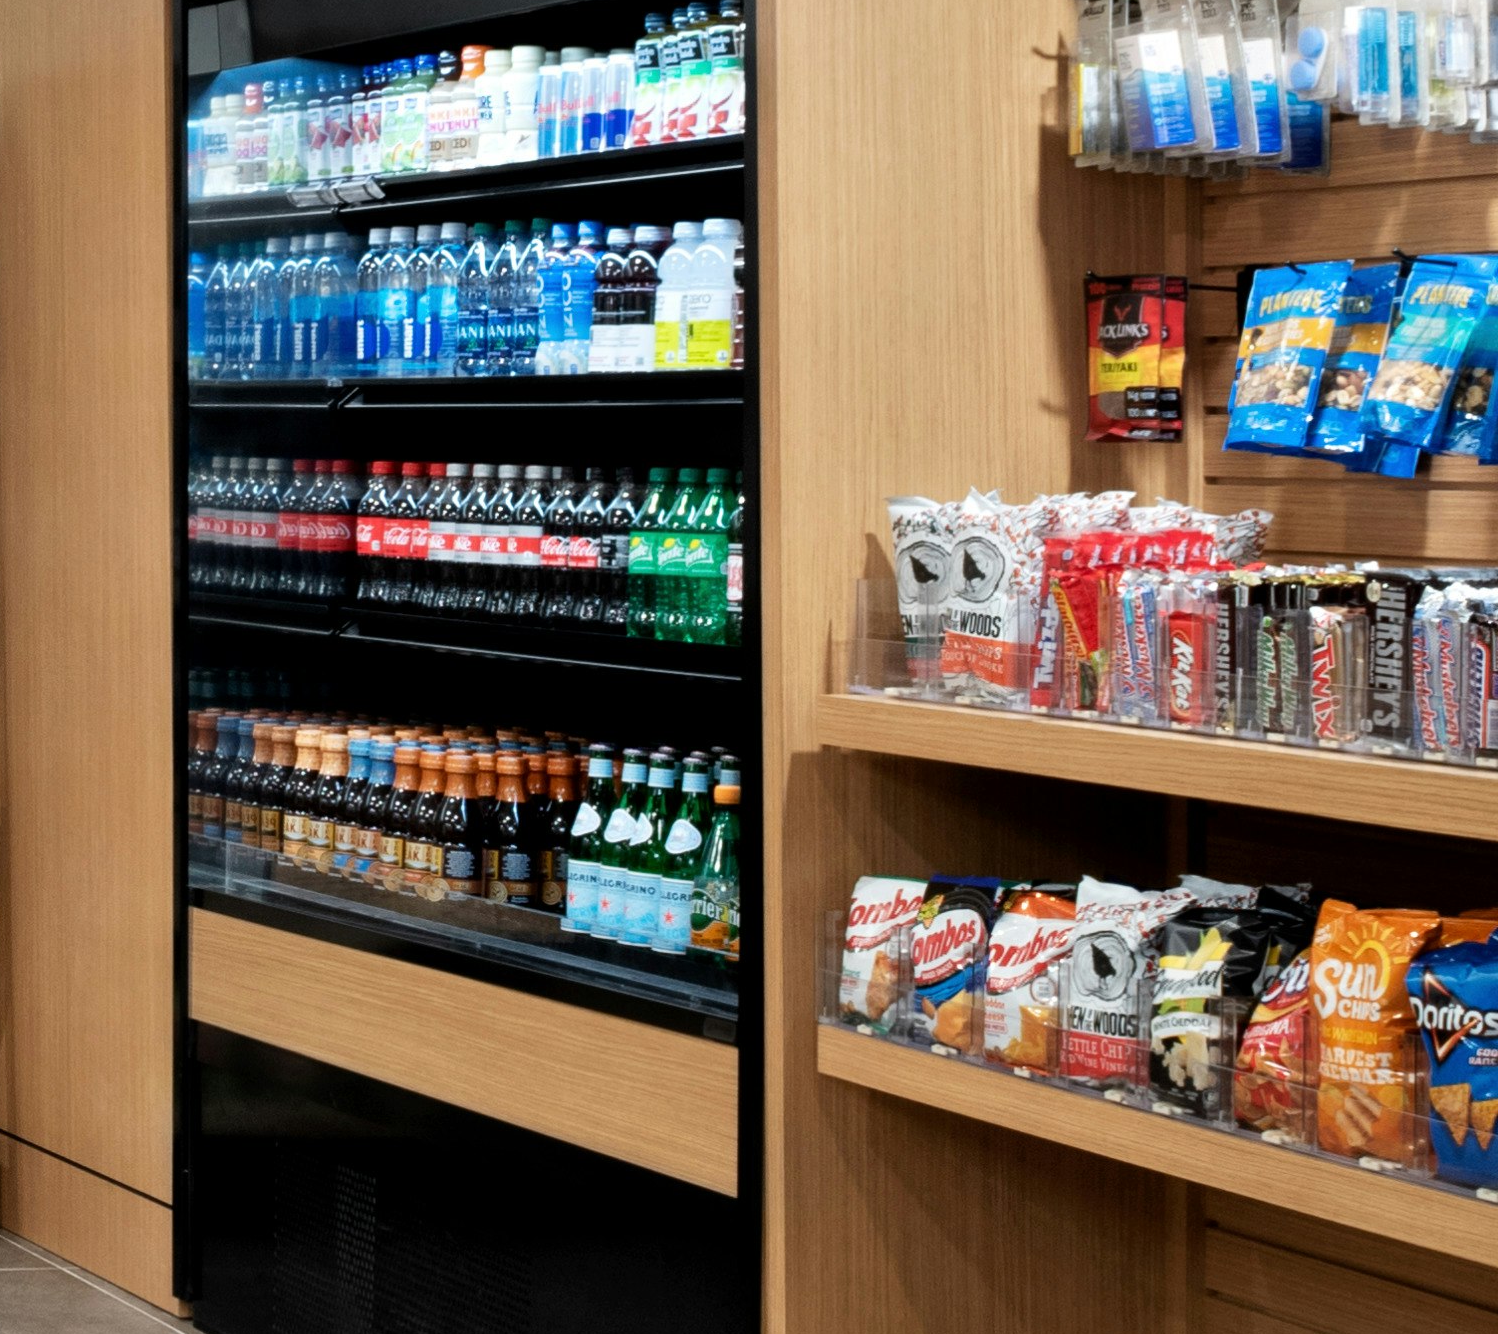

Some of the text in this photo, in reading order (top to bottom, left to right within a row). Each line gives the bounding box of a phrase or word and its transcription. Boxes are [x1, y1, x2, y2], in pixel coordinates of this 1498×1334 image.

[1259, 289, 1328, 318] PLANTERS
[1409, 284, 1474, 310] PLANTERS
[960, 611, 1001, 638] WOODS
[1374, 587, 1404, 731] HERSHEY'S
[1313, 957, 1384, 1020] Sun
[1337, 999, 1382, 1022] CHIPS
[1094, 1011, 1137, 1038] WOODS
